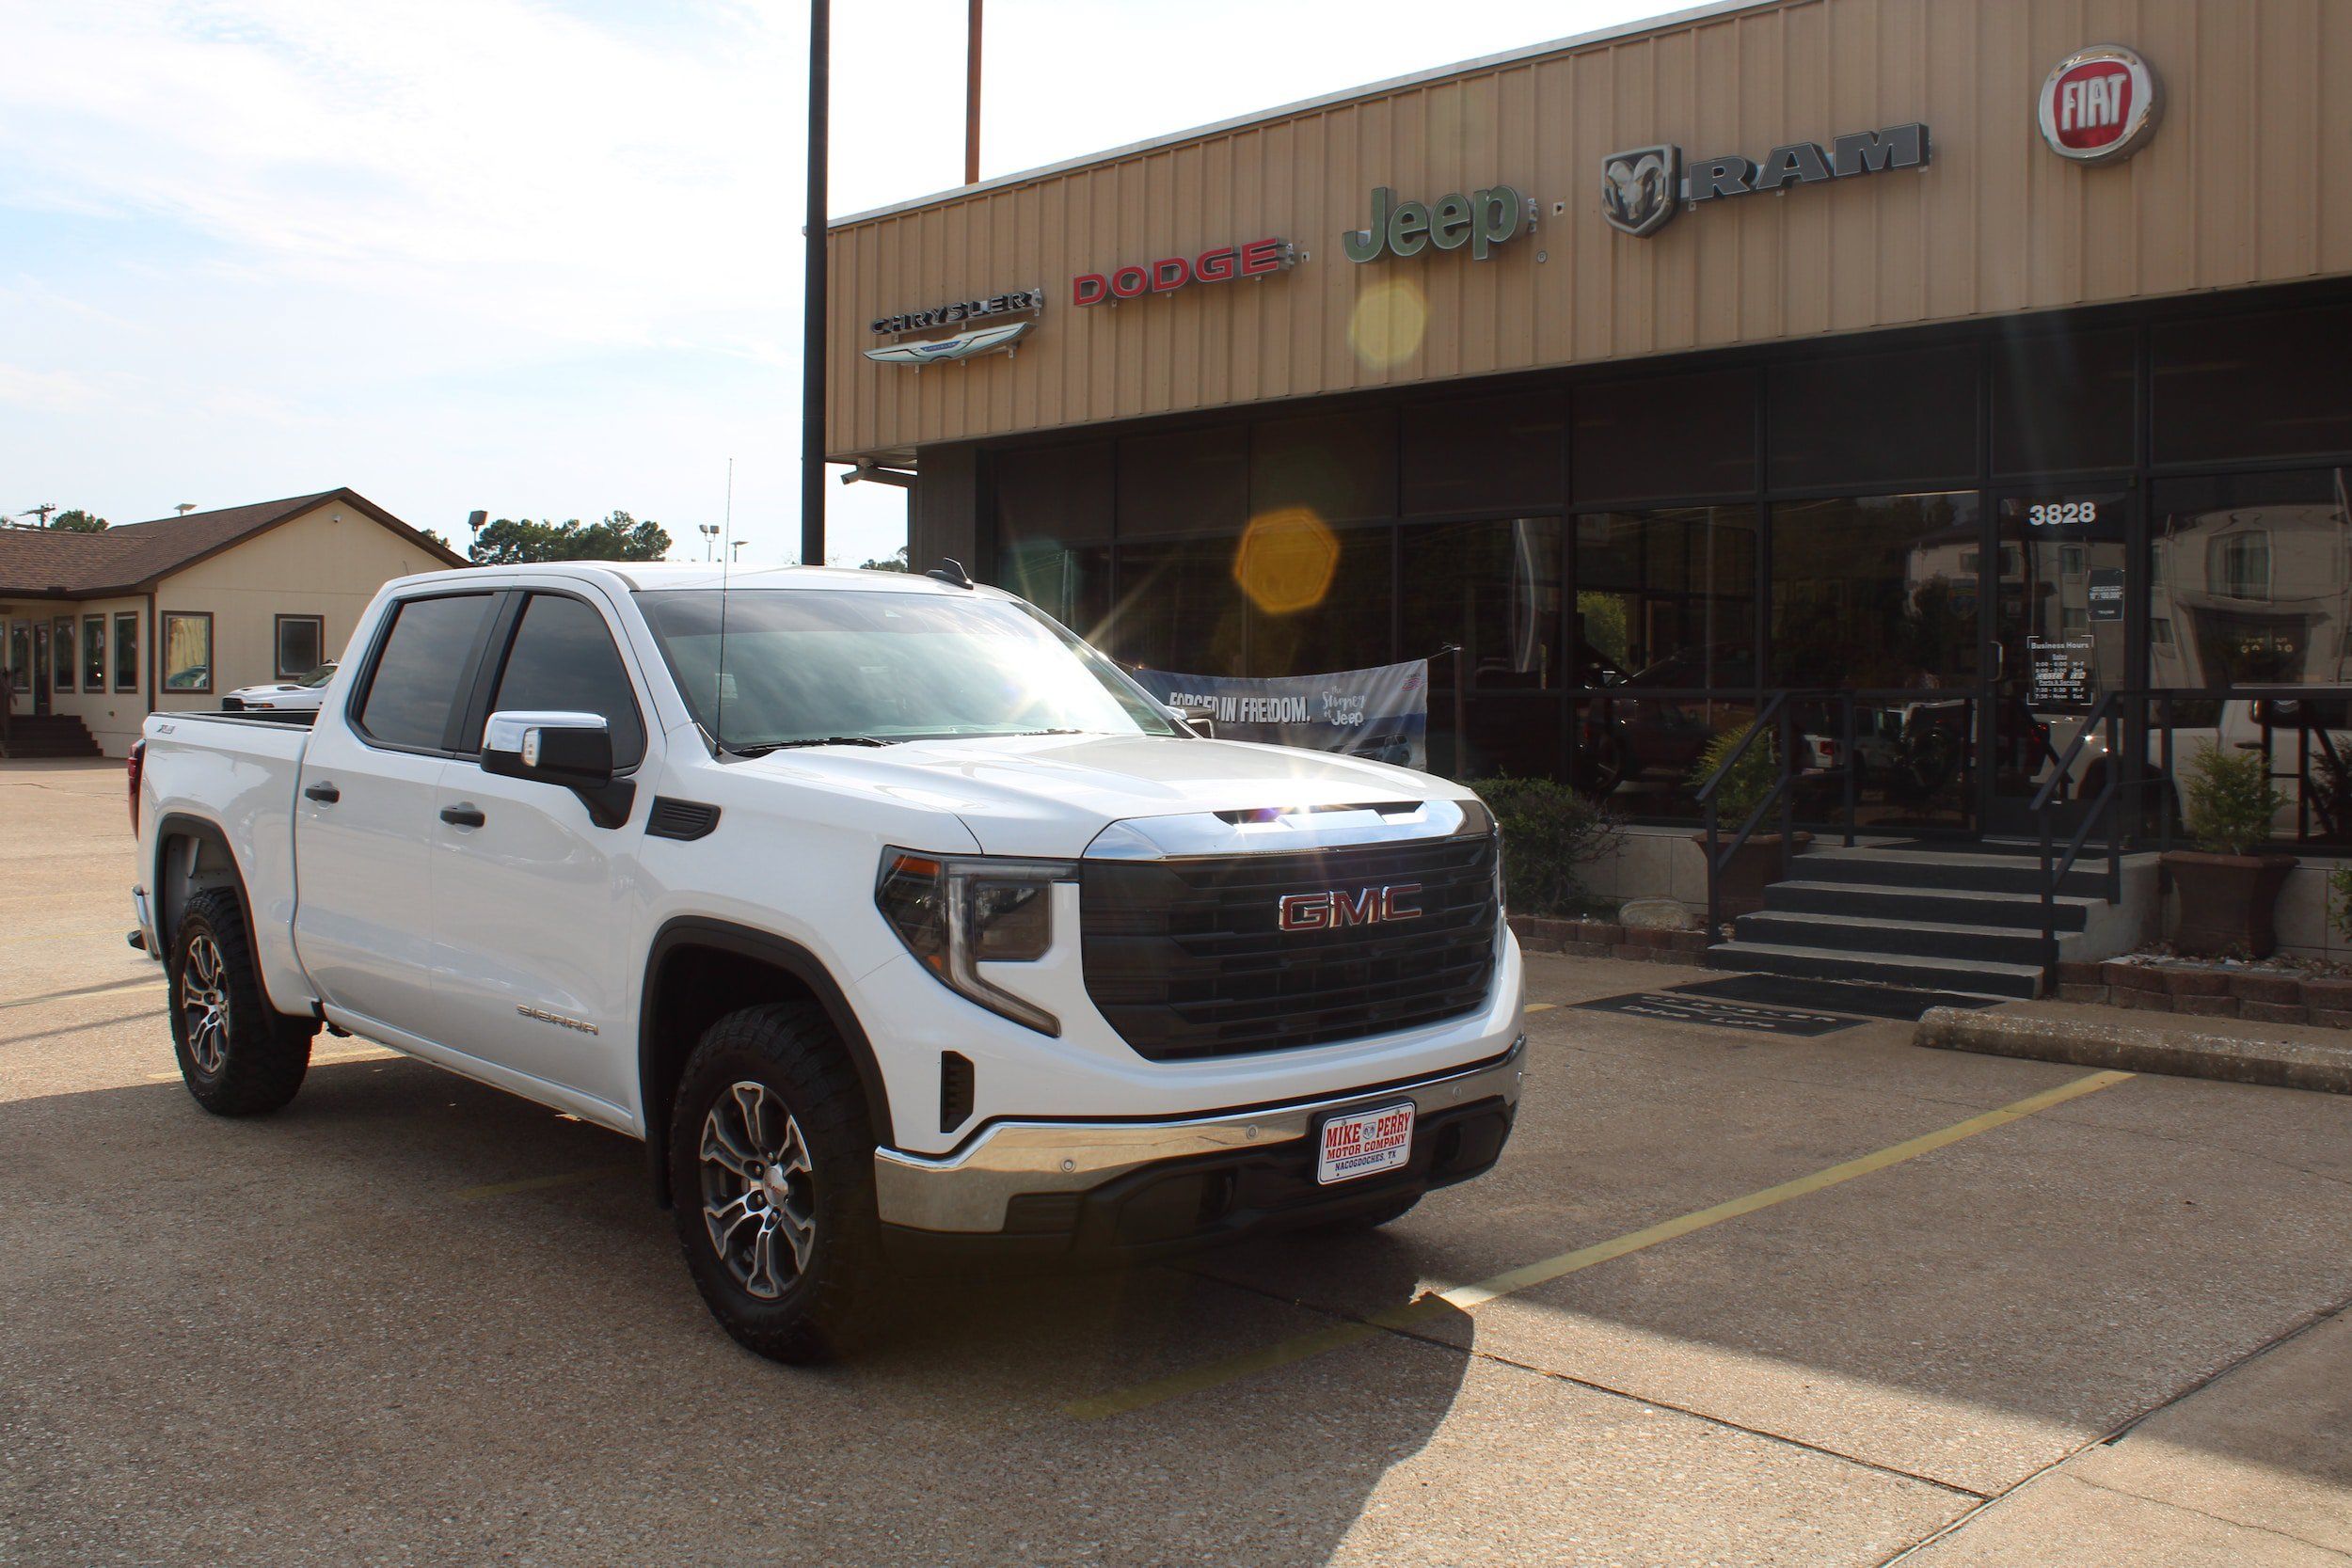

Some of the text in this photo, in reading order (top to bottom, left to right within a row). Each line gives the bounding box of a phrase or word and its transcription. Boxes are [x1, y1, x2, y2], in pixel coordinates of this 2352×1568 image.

[2061, 72, 2127, 132] FIAT
[1689, 122, 1930, 203] RAM
[1342, 184, 1522, 263] Jeep
[1073, 237, 1283, 307] DODGE
[870, 291, 1037, 335] CHRYSLER
[2029, 501, 2096, 526] 3828
[1220, 697, 1237, 722] IN
[1331, 710, 1364, 726] Jeep
[1279, 882, 1422, 931] GMC
[516, 1003, 599, 1036] SIERRA
[1325, 1111, 1412, 1149] MIKE PERRY
[1327, 1132, 1407, 1161] MOTOR COMPANY
[1388, 1149, 1396, 1160] TX
